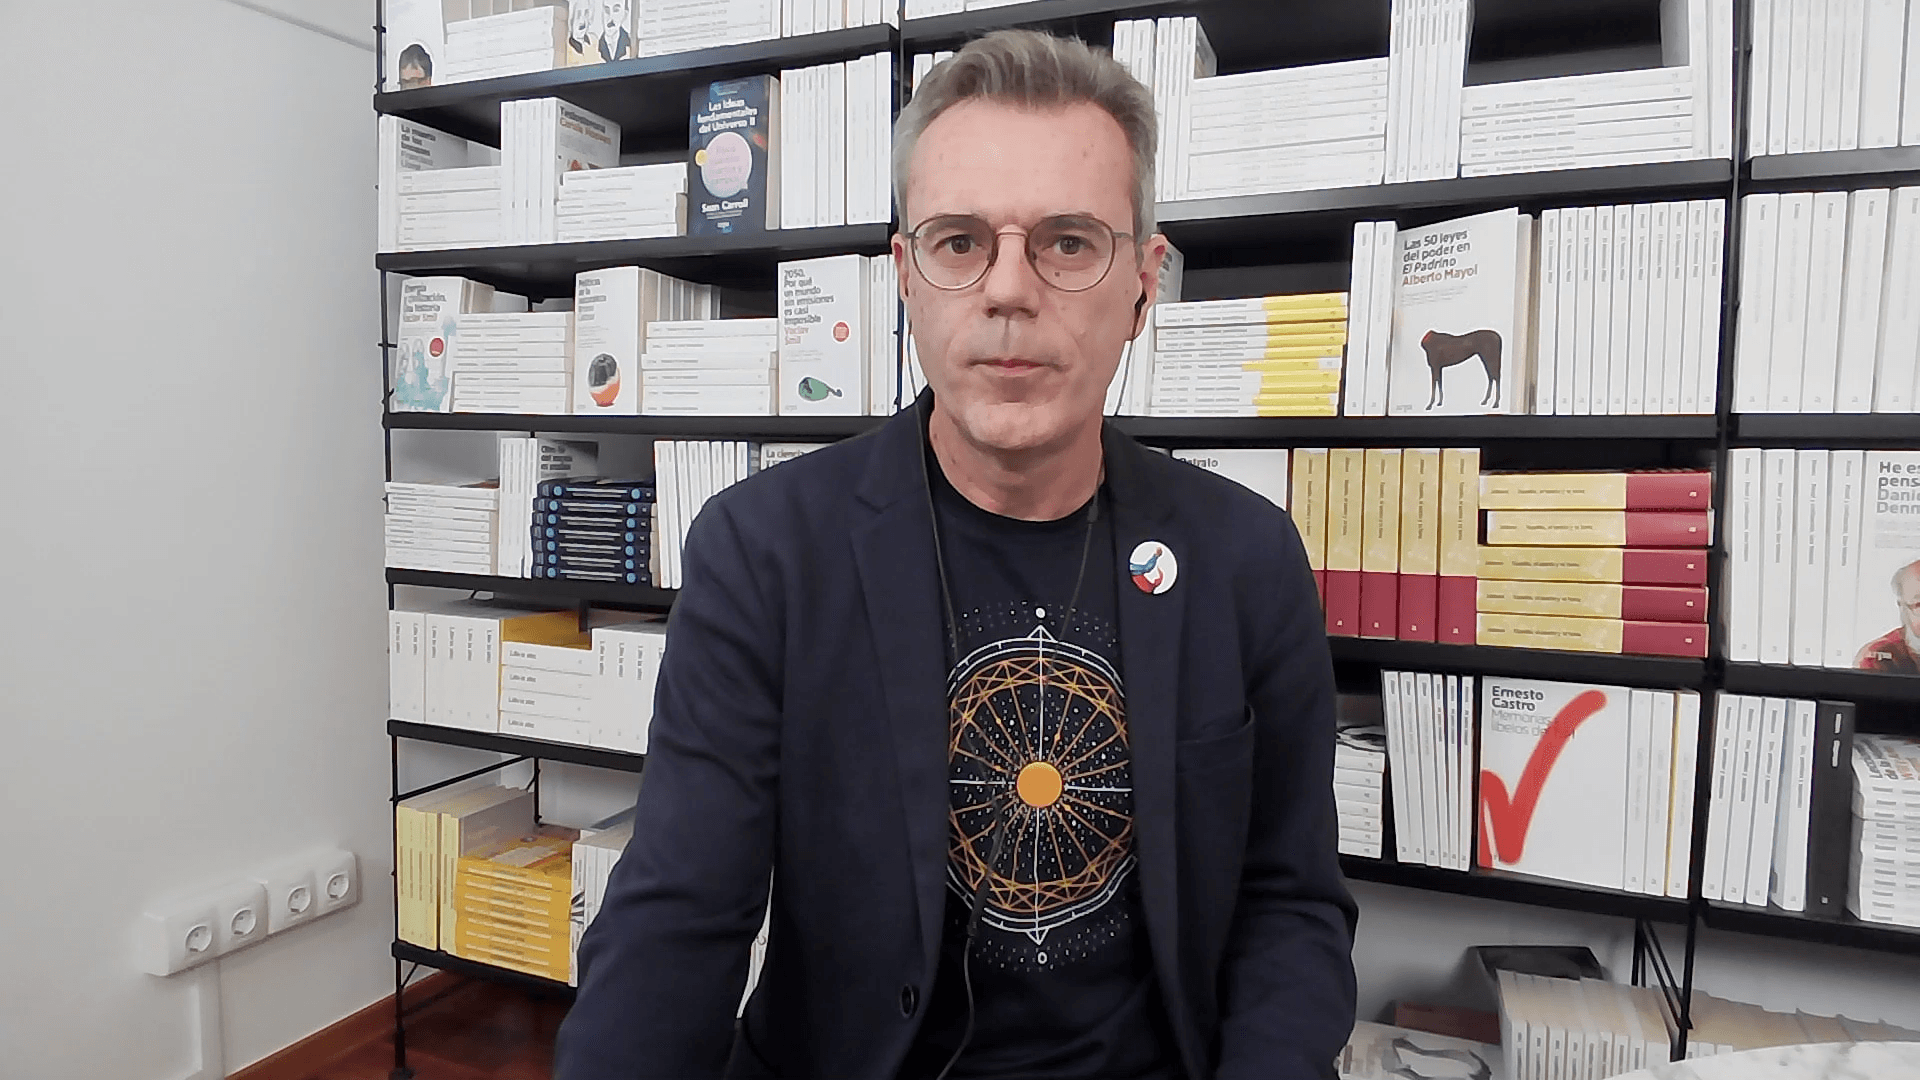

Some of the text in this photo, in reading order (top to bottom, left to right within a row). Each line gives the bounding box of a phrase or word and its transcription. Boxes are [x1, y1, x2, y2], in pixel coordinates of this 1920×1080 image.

[721, 198, 749, 211] Carroll
[1404, 230, 1468, 251] Las 50 leyes
[1403, 242, 1471, 262] del poder en
[1402, 257, 1457, 275] El Padrino
[1402, 264, 1478, 287] Alberto Mayol
[795, 286, 822, 297] mundo
[766, 449, 775, 458] La
[1879, 461, 1920, 475] He e
[1492, 685, 1544, 701] Ernesto
[1491, 697, 1536, 711] Castro
